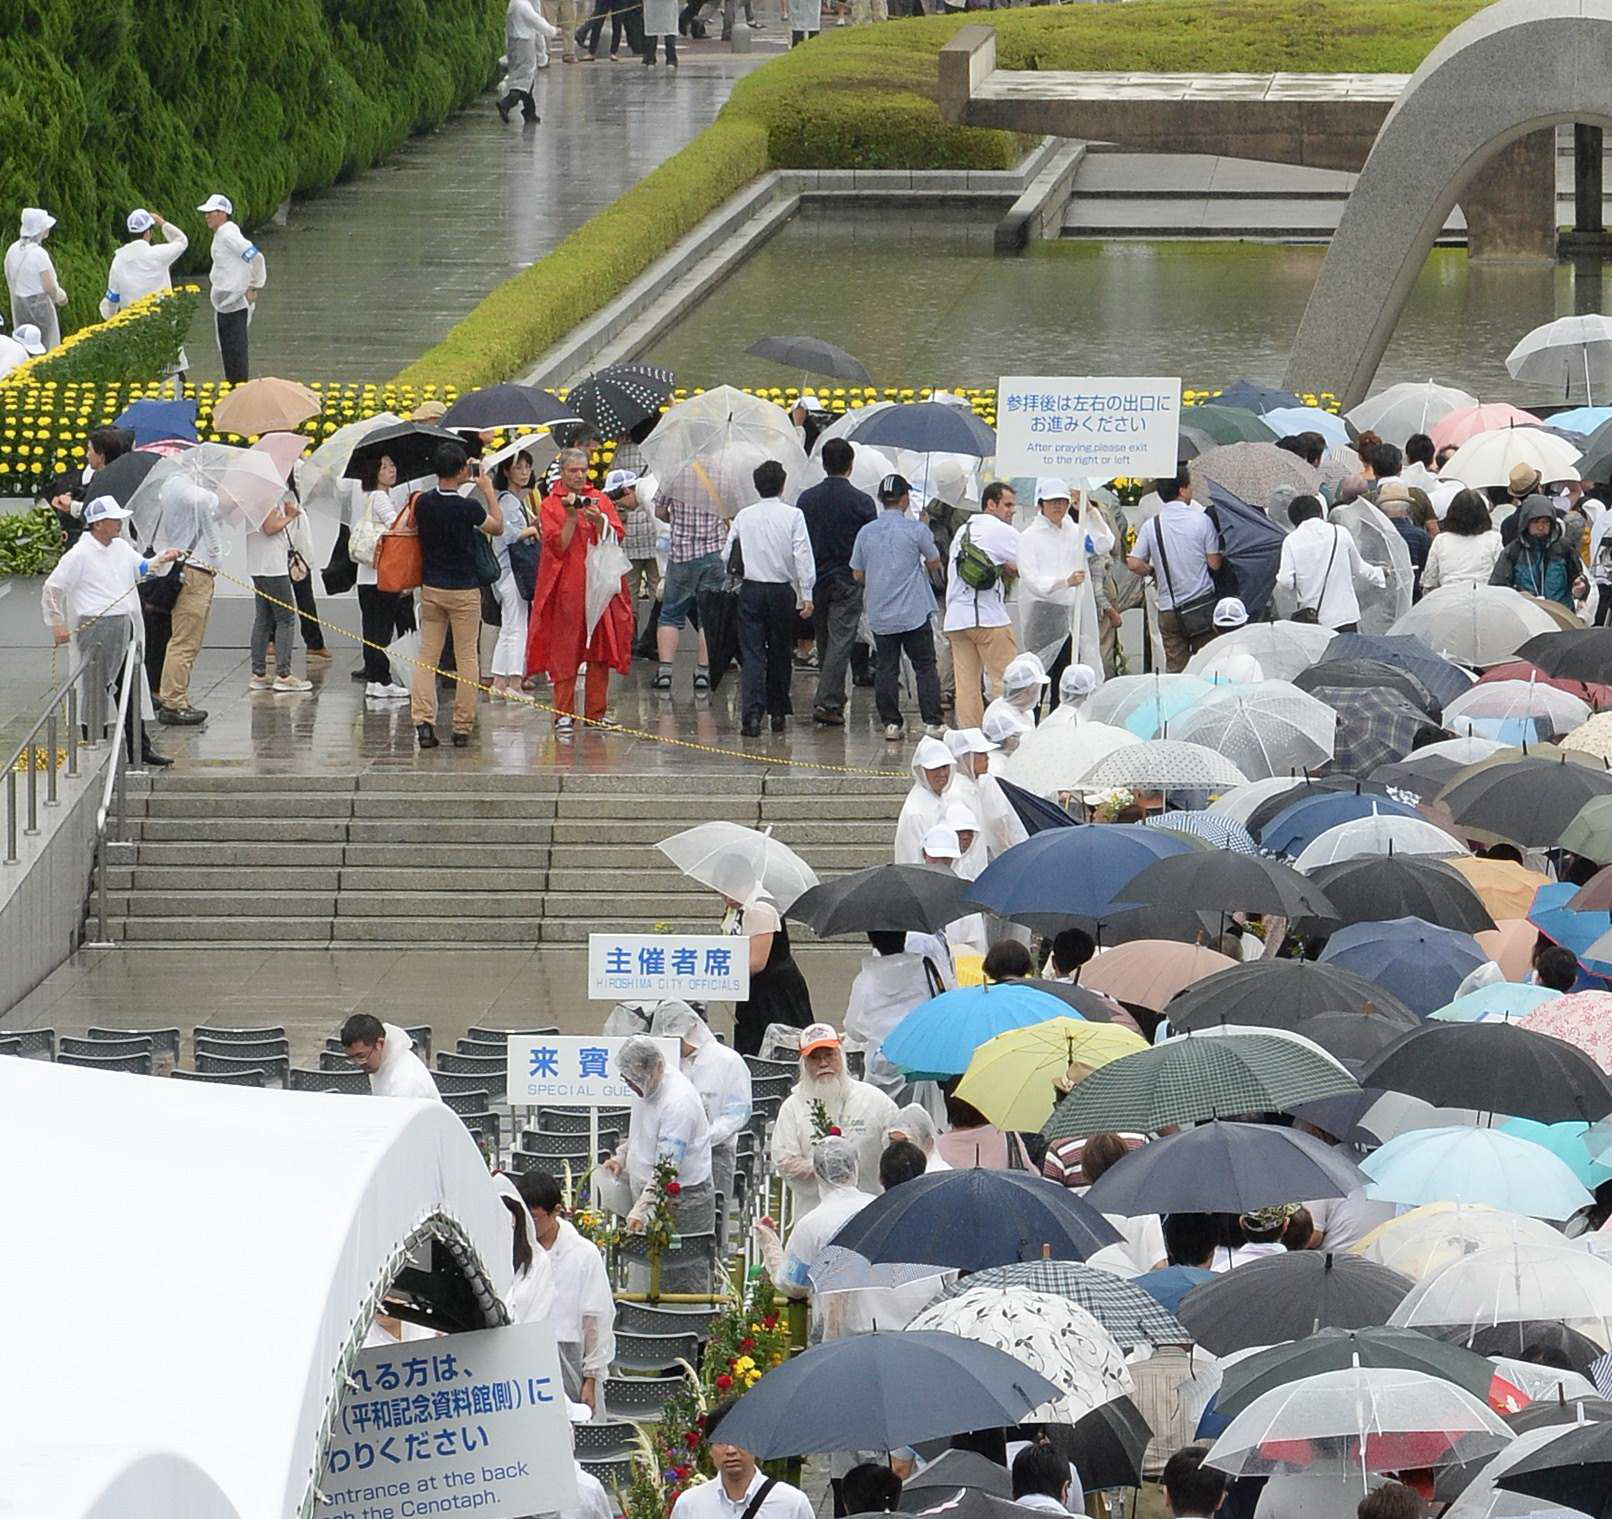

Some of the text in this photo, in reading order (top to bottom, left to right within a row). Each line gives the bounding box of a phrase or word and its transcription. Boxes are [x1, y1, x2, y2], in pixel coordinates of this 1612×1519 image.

[1007, 394, 1171, 413] 参拝後は左右の出口に
[1031, 416, 1147, 433] お進みください
[1026, 442, 1051, 452] After
[1129, 442, 1148, 452] exit
[1043, 454, 1130, 466] to the right or left
[606, 947, 732, 976] 主催者席
[596, 978, 740, 991] HIROSHIMA CITY OFFICIALS
[528, 1084, 633, 1097] SPECIAL GUE
[323, 1461, 530, 1507] entrance at the back
[401, 1489, 501, 1518] Cenotaph.
